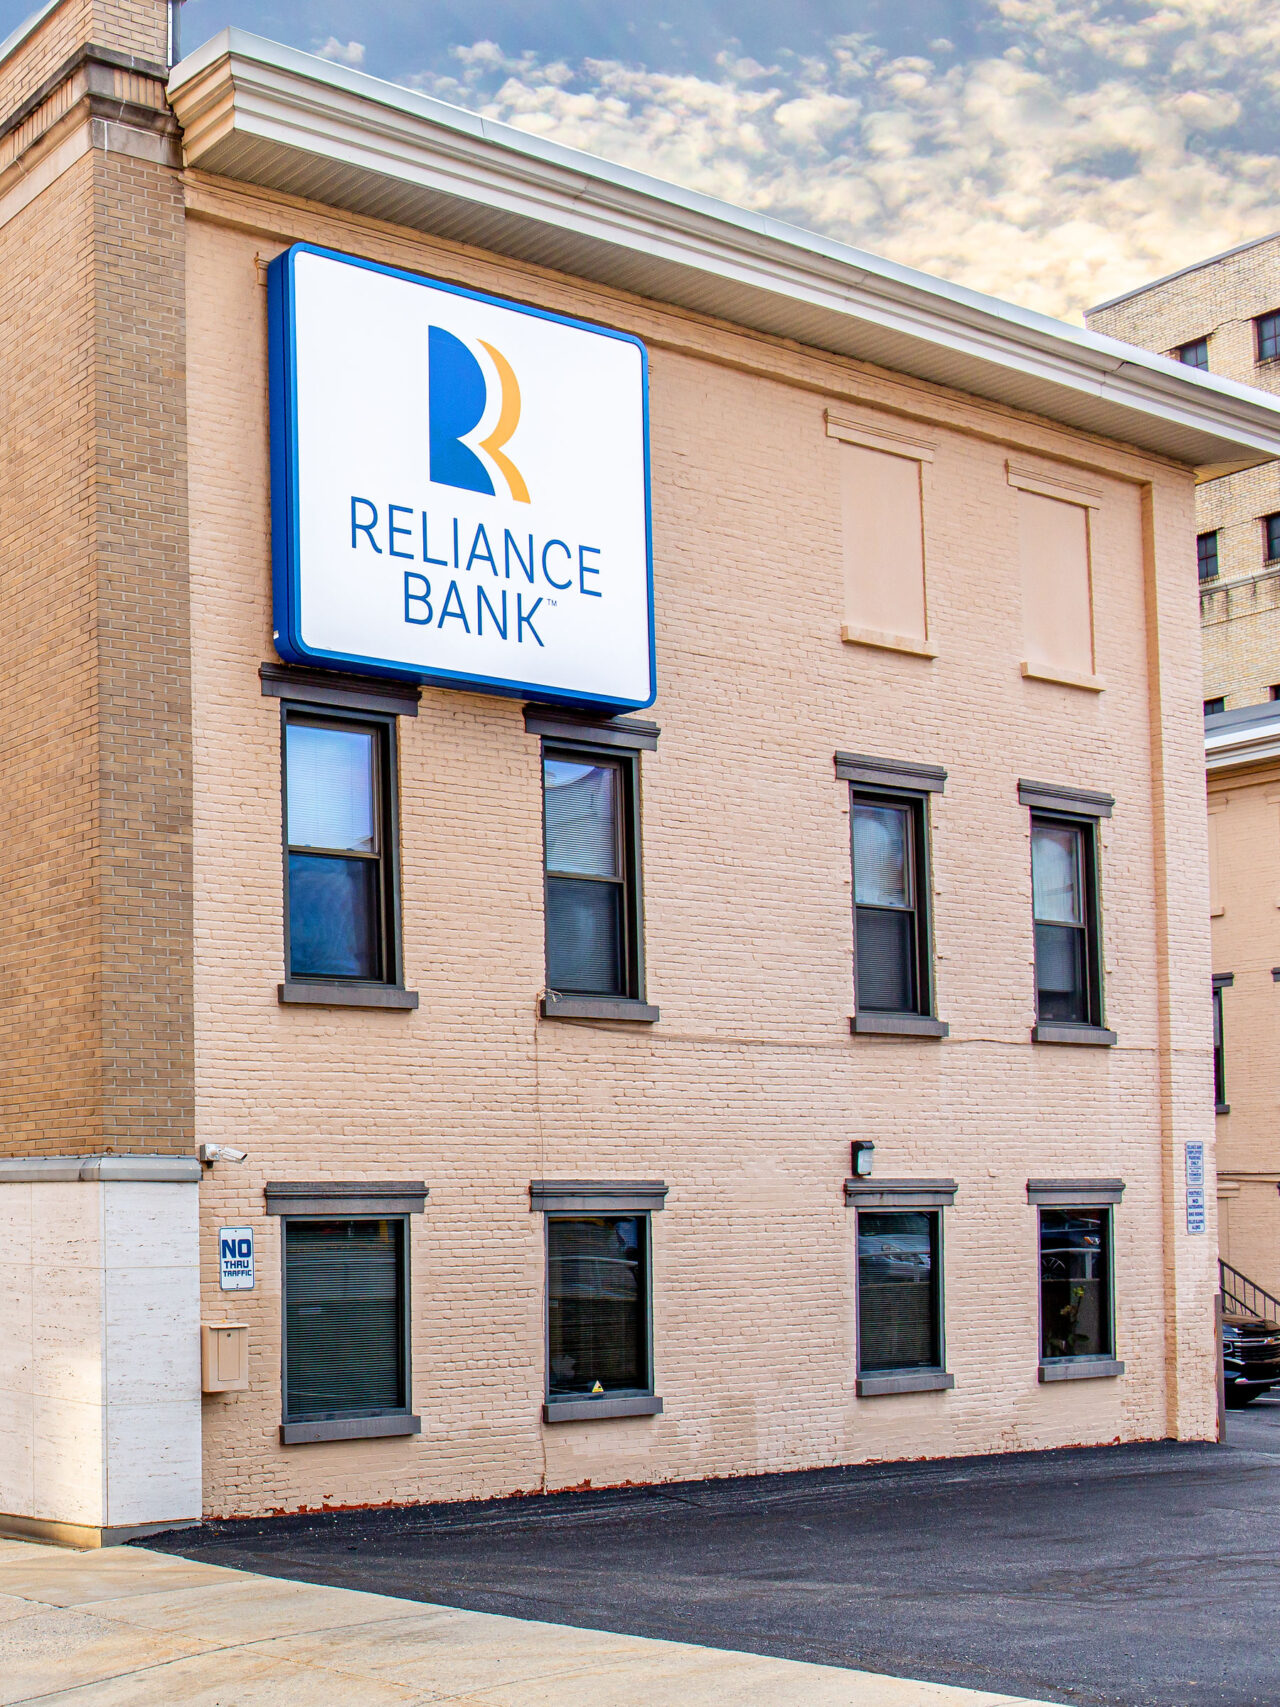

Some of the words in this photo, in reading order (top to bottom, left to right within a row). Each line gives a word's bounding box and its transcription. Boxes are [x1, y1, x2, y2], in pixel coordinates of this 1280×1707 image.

[351, 496, 602, 598] RELIANCE
[404, 571, 544, 647] BANK
[222, 1239, 251, 1258] NO
[223, 1269, 252, 1277] TRAFFIC
[224, 1260, 249, 1269] THRU
